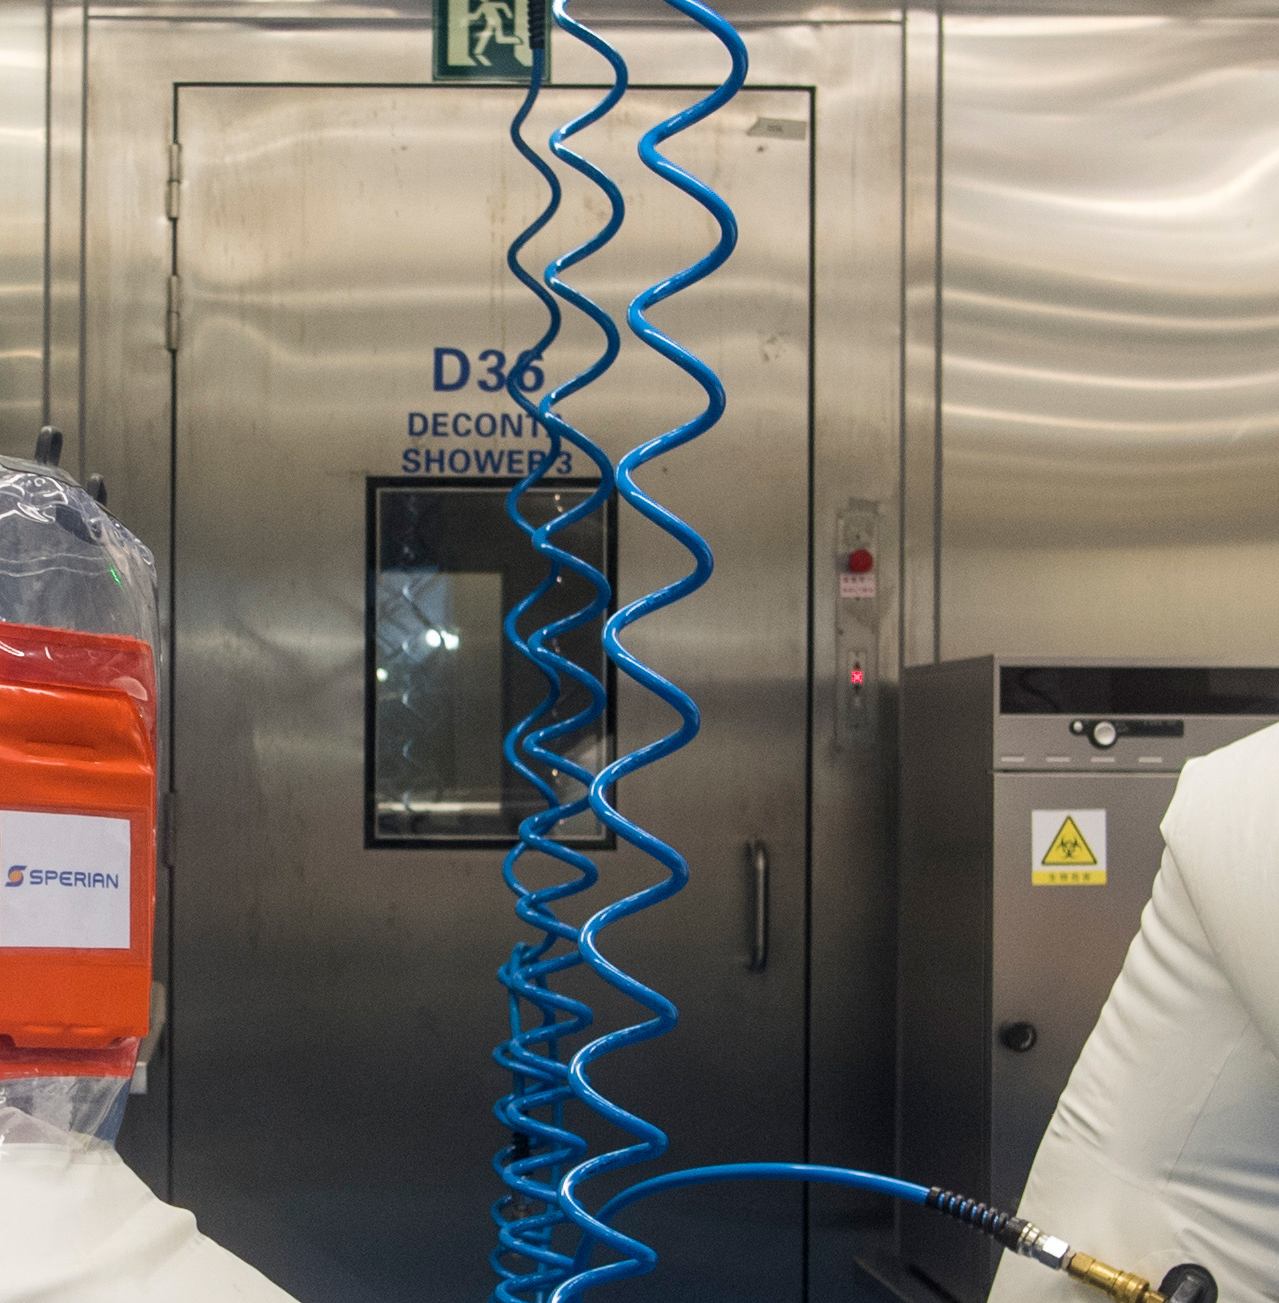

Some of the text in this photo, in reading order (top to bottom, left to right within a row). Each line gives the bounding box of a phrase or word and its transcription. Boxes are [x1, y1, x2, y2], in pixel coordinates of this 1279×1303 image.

[432, 347, 545, 393] D36
[401, 449, 573, 475] SHOWER 3
[29, 869, 119, 889] SPERIAN
